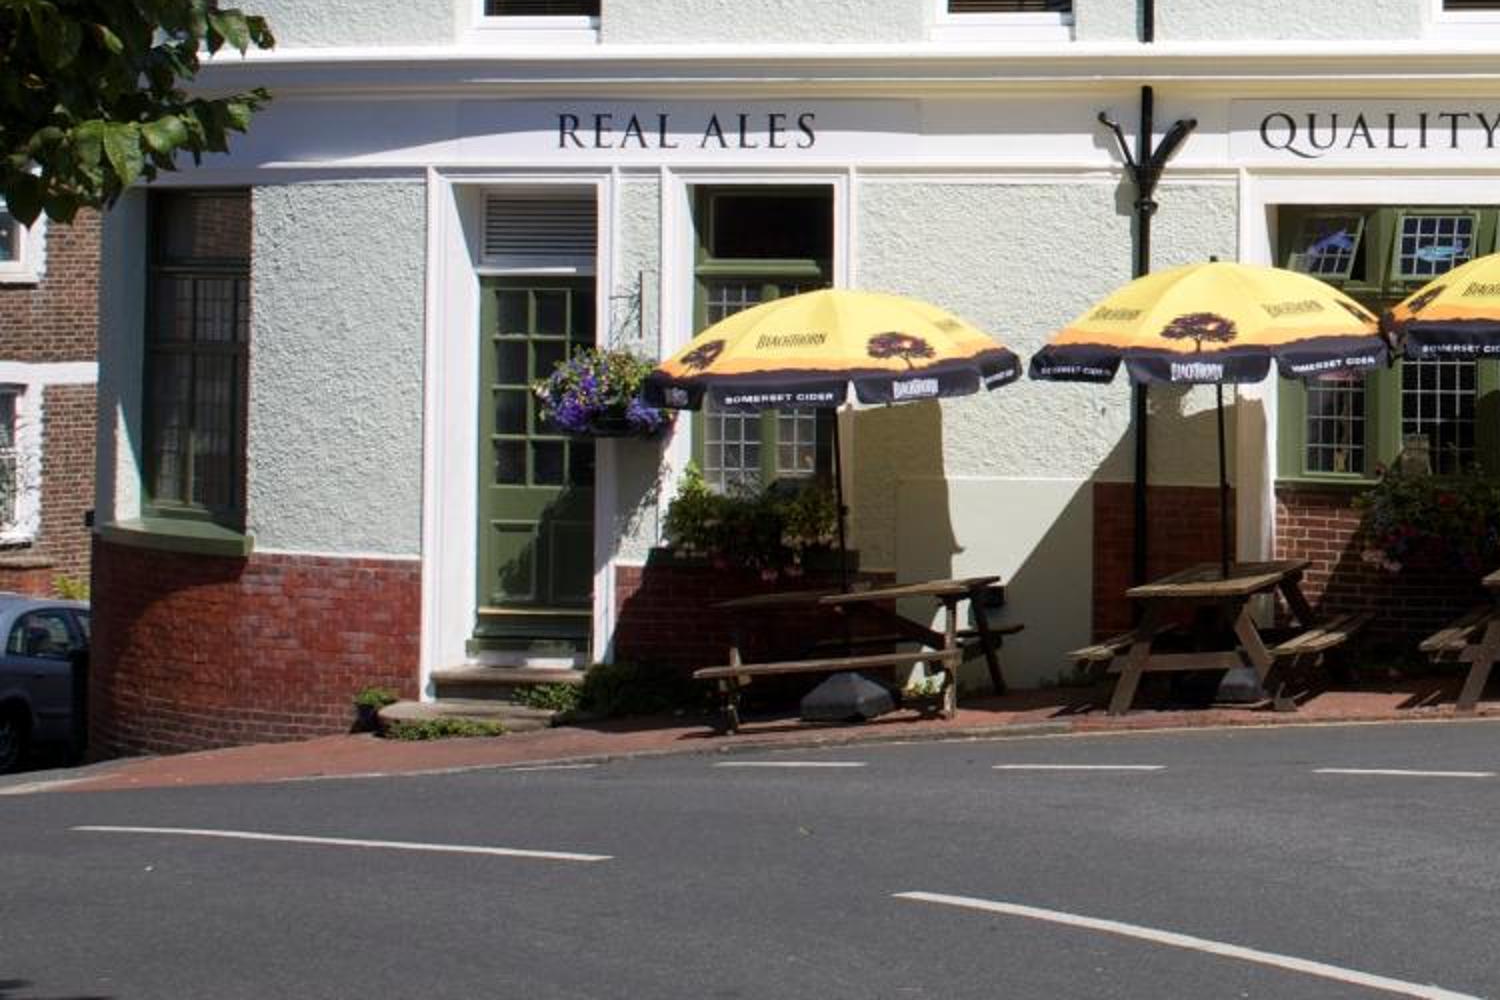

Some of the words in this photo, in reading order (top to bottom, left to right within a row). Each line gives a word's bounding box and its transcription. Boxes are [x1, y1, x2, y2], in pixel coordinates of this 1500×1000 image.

[558, 112, 678, 149] REAL
[700, 112, 816, 149] ALES
[1422, 344, 1480, 353] SOMERSET
[724, 393, 793, 405] SOMERSET
[796, 392, 834, 402] CIDER
